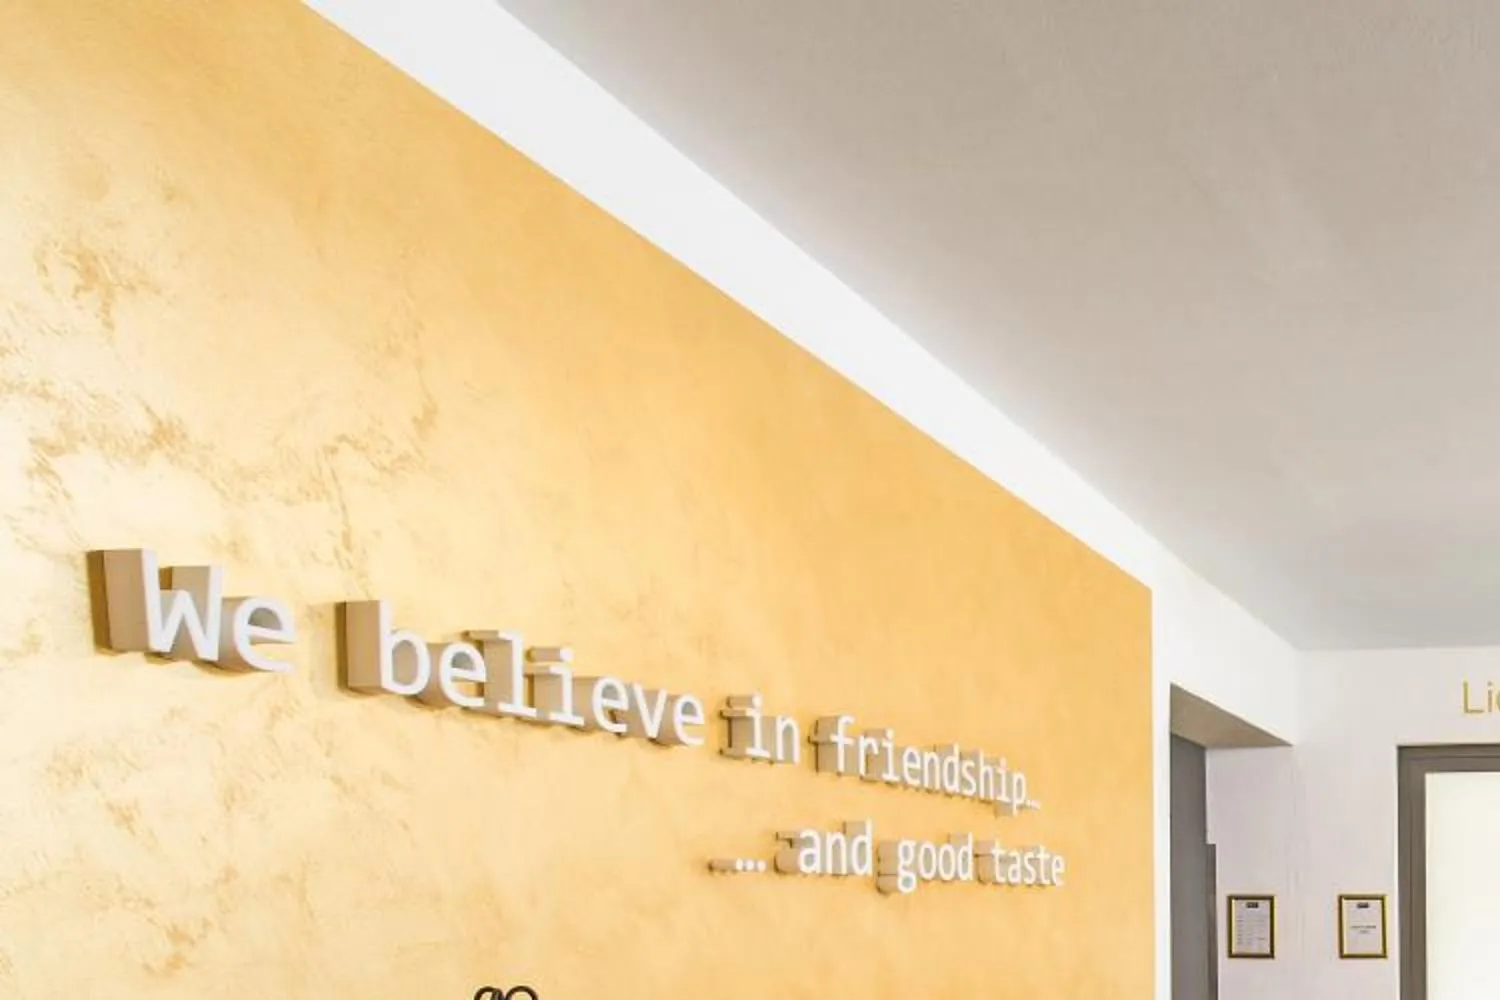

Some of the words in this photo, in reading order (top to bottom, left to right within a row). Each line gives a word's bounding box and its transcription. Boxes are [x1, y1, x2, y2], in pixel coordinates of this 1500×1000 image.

[141, 547, 296, 672] We
[379, 598, 705, 746] believe
[744, 694, 800, 764] in
[896, 832, 974, 893] good
[990, 840, 1066, 887] taste
